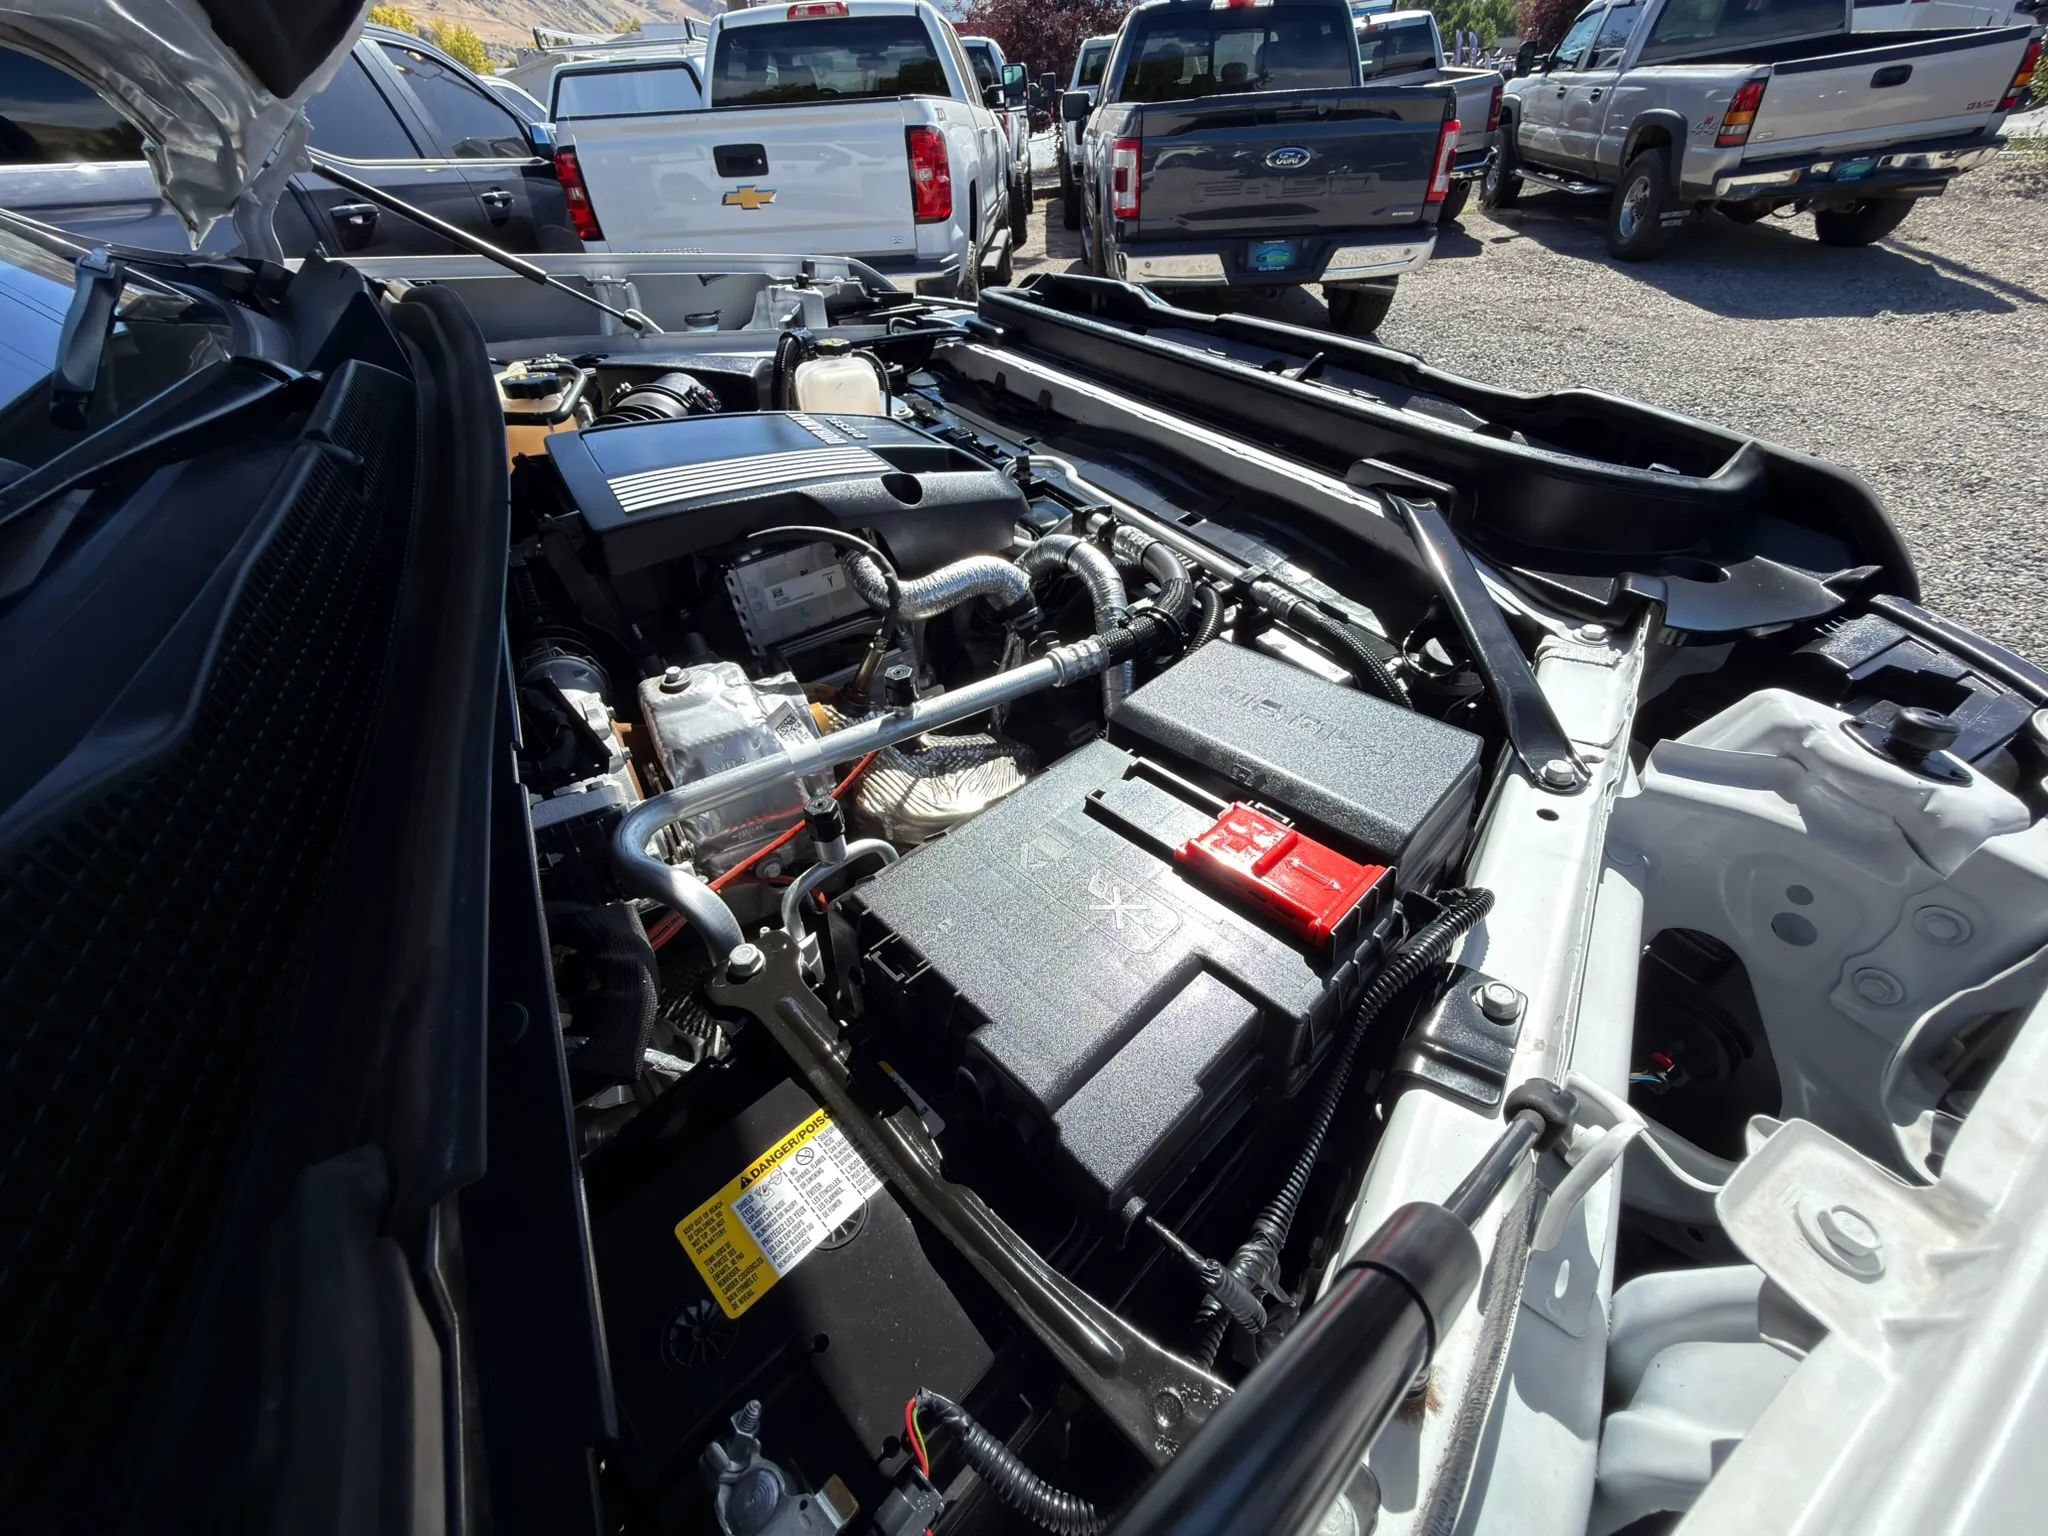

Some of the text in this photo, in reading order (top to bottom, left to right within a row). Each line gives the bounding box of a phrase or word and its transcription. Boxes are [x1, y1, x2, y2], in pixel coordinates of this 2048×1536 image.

[1966, 100, 1996, 110] GMC
[1276, 152, 1301, 165] Ford
[749, 1109, 834, 1179] DANGER/POISO
[823, 1136, 834, 1147] ACID
[828, 1145, 837, 1154] CAN
[810, 1154, 826, 1170] FLAMES
[838, 1152, 853, 1166] SEVERE
[789, 1167, 798, 1177] NO
[799, 1167, 825, 1190] OR SMOKING
[851, 1170, 861, 1180] PEUT
[736, 1194, 755, 1212] SHIELD
[811, 1195, 821, 1205] LES
[817, 1202, 826, 1212] LES
[821, 1198, 843, 1219] DE FUMER
[683, 1200, 724, 1234] KEEP OUT OF REACH
[741, 1205, 755, 1219] EYES
[746, 1204, 768, 1225] EXPLOSIVE
[750, 1199, 786, 1232] GASES CAN CAUSE
[755, 1200, 798, 1239] BLINDNESS OR INJURY
[784, 1216, 795, 1227] LES
[793, 1206, 807, 1220] YEUX
[687, 1233, 695, 1241] OF
[715, 1210, 723, 1219] DO
[691, 1237, 702, 1248] NOT
[709, 1225, 718, 1234] DO
[716, 1218, 726, 1228] NOT
[695, 1228, 727, 1255] OPEN BATTERY
[767, 1219, 805, 1255] LES GAZ EXPLOSIFS
[772, 1222, 814, 1262] PEUVENT BLESSER OU
[703, 1241, 732, 1267] TENIR HORS DE
[708, 1266, 715, 1274] LA
[727, 1248, 737, 1258] DES
[777, 1236, 812, 1269] RENDRE AVEUGLE
[721, 1256, 764, 1295] GARDER COUVERCLES
[726, 1291, 738, 1303] BIEN
[751, 1273, 759, 1282] ET
[731, 1301, 739, 1310] DE
